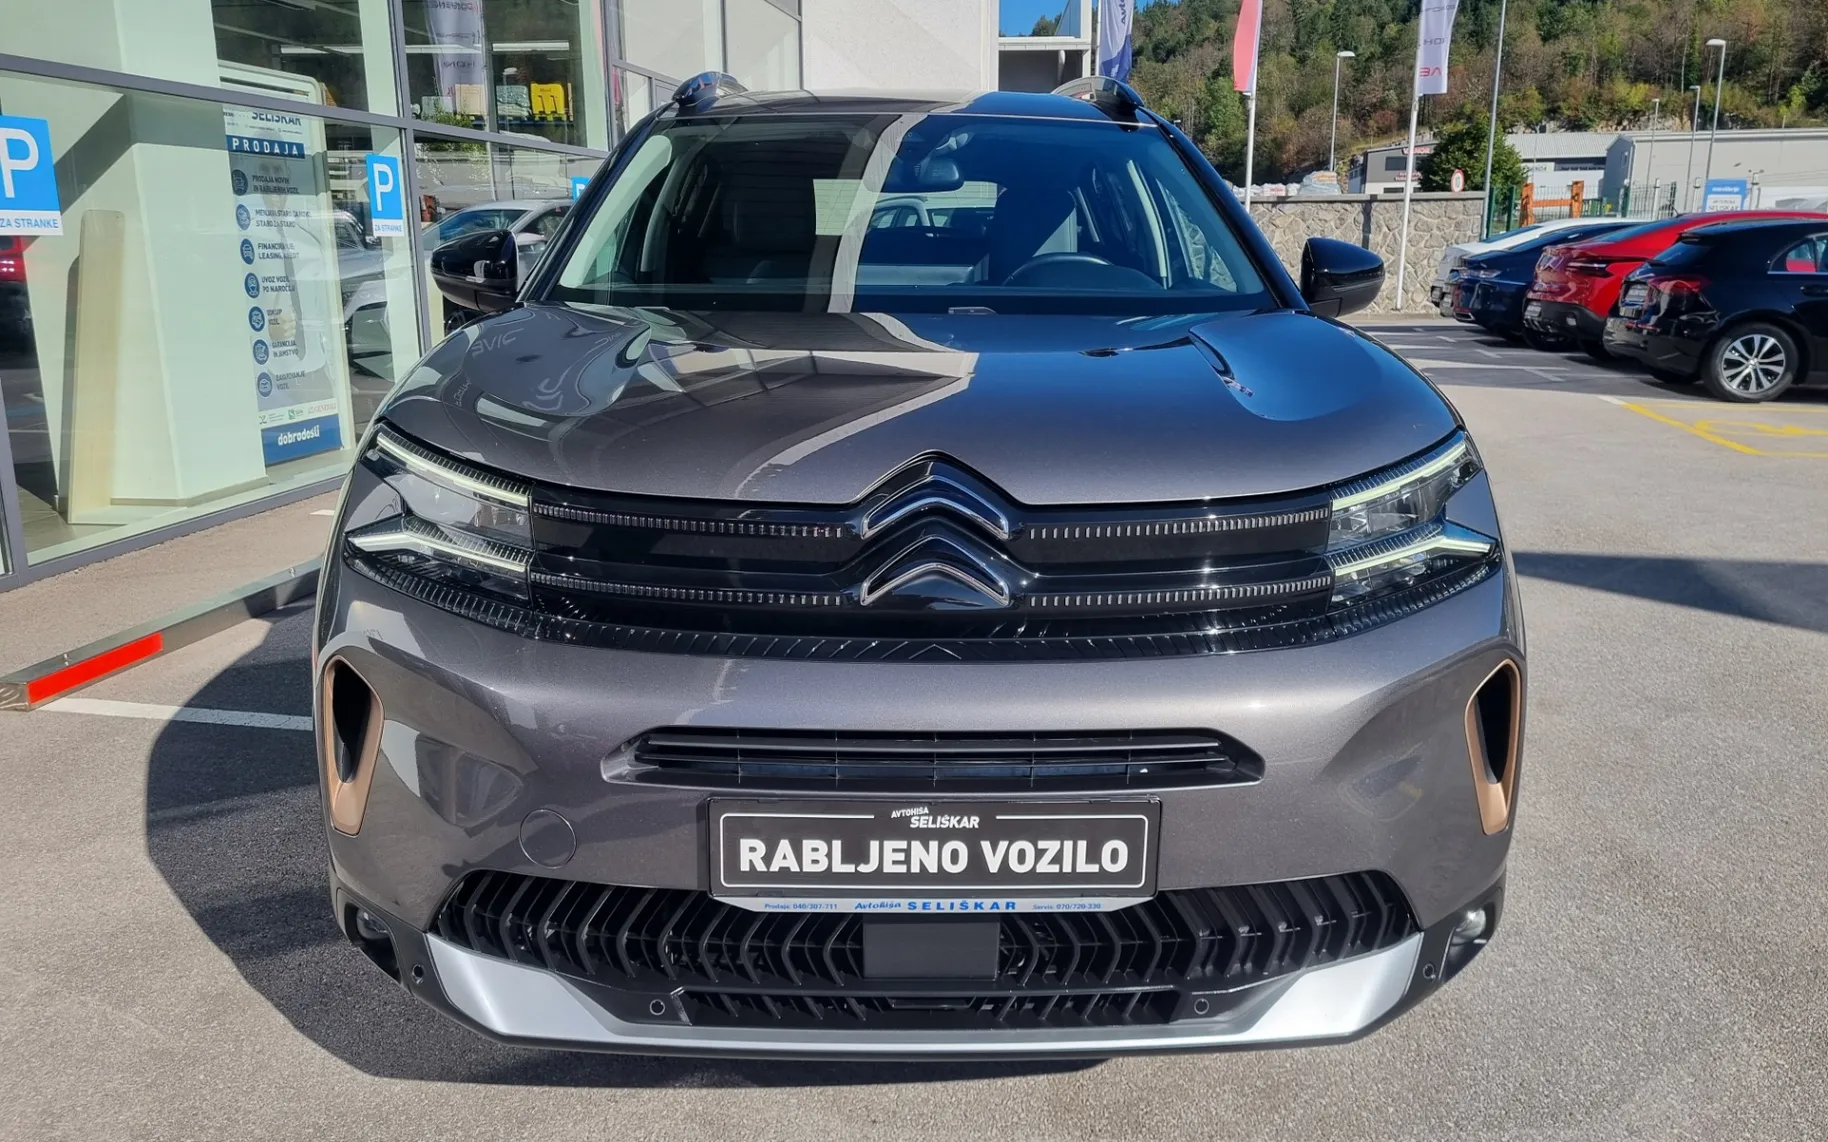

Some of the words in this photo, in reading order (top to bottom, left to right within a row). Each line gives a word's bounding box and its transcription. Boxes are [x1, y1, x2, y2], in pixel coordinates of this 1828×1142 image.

[232, 138, 299, 155] PRODAJA
[0, 127, 39, 198] P
[373, 163, 394, 211] P
[0, 218, 12, 228] ZA
[15, 218, 59, 228] STRANKE
[910, 814, 980, 828] SELIŠKAR
[740, 838, 968, 873] RABLJENO
[980, 839, 1128, 873] VOZILO
[907, 900, 1016, 910] SELIŠKAR
